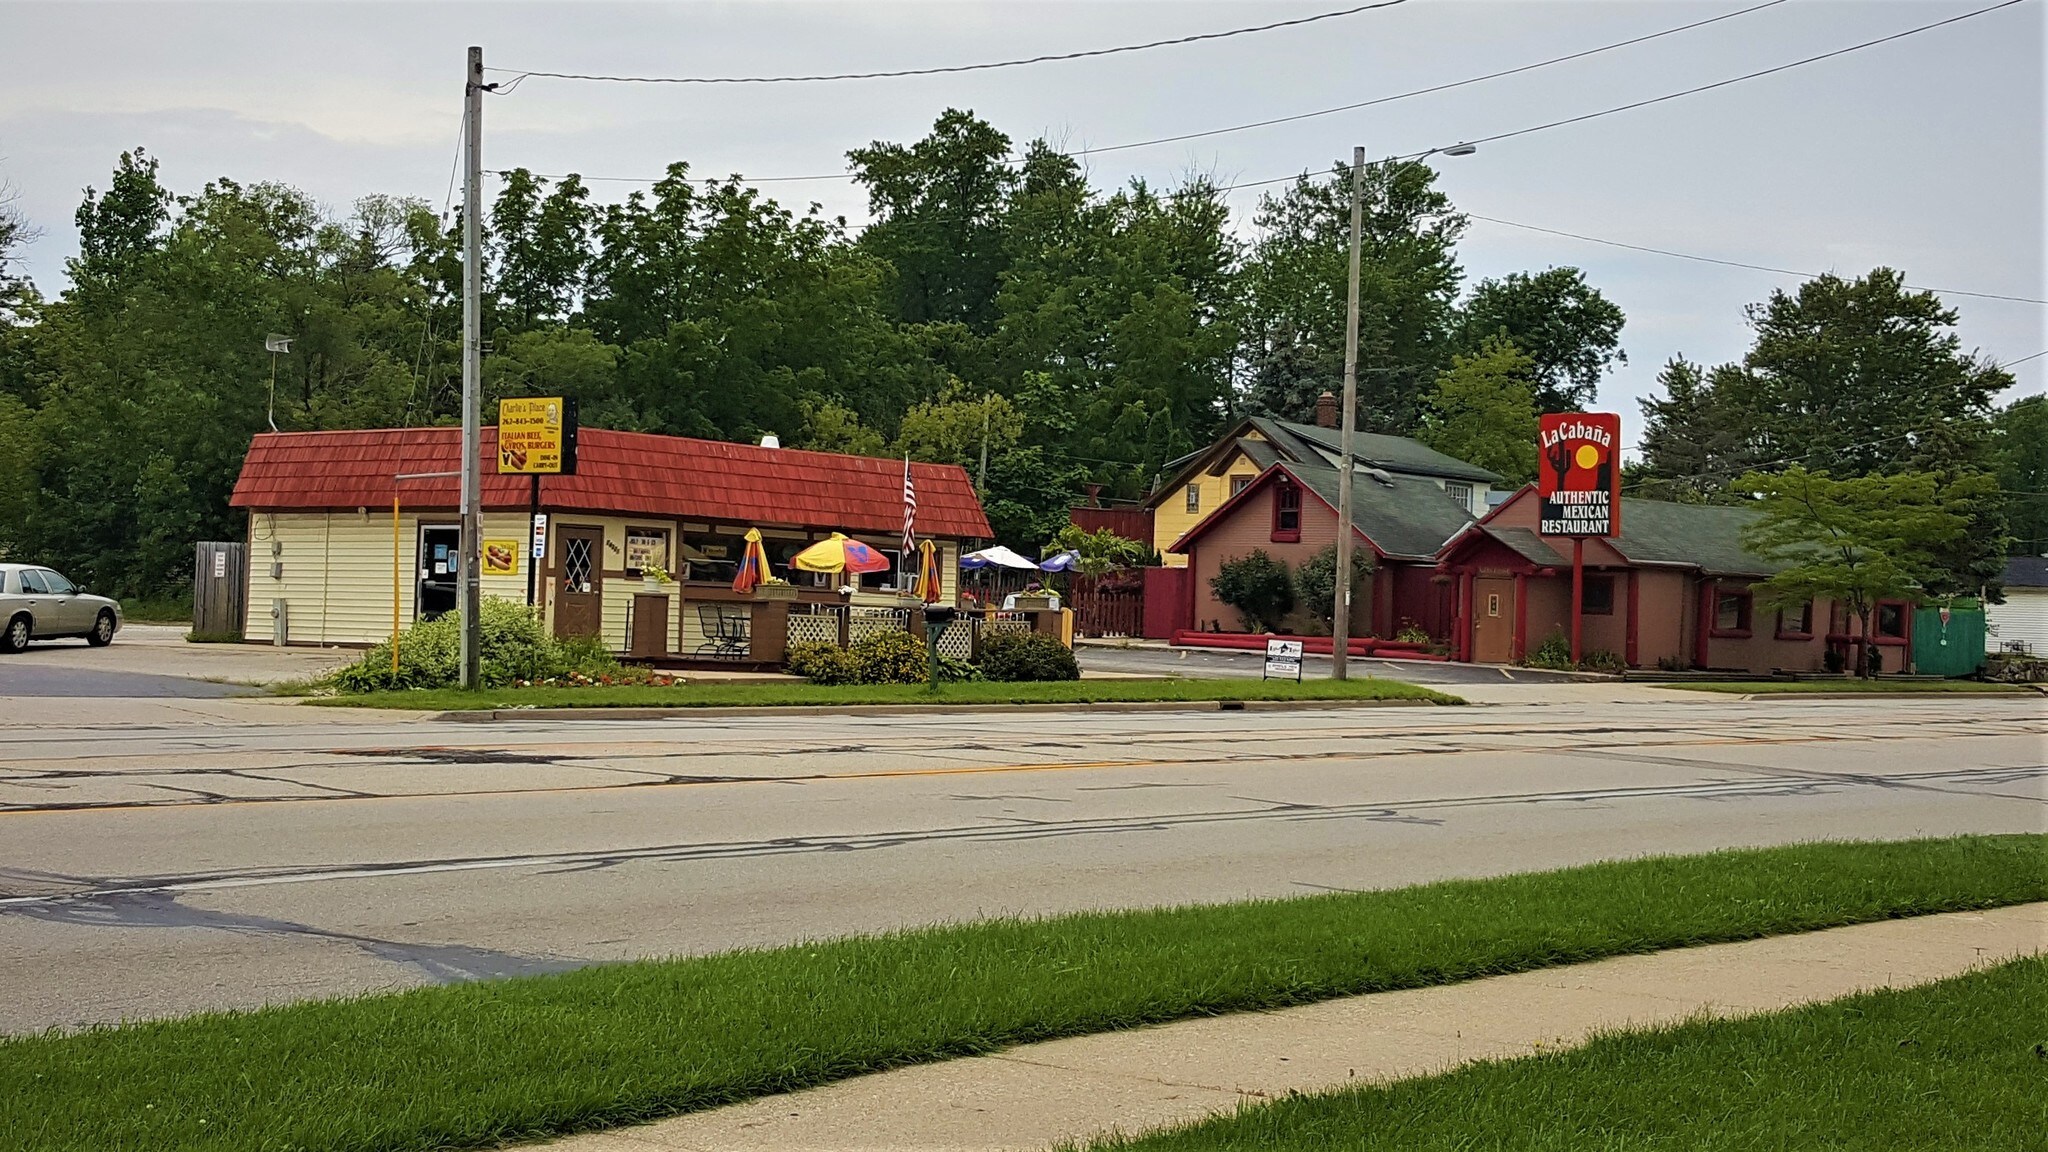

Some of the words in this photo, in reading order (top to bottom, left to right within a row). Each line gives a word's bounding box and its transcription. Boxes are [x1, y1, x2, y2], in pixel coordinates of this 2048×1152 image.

[529, 402, 545, 414] Place
[502, 432, 526, 440] ITALIAN
[527, 441, 556, 450] BURGERS
[1549, 491, 1609, 504] AUTHENTIC
[1562, 505, 1609, 519] MEXICAN
[1541, 520, 1609, 533] RESTAURANT
